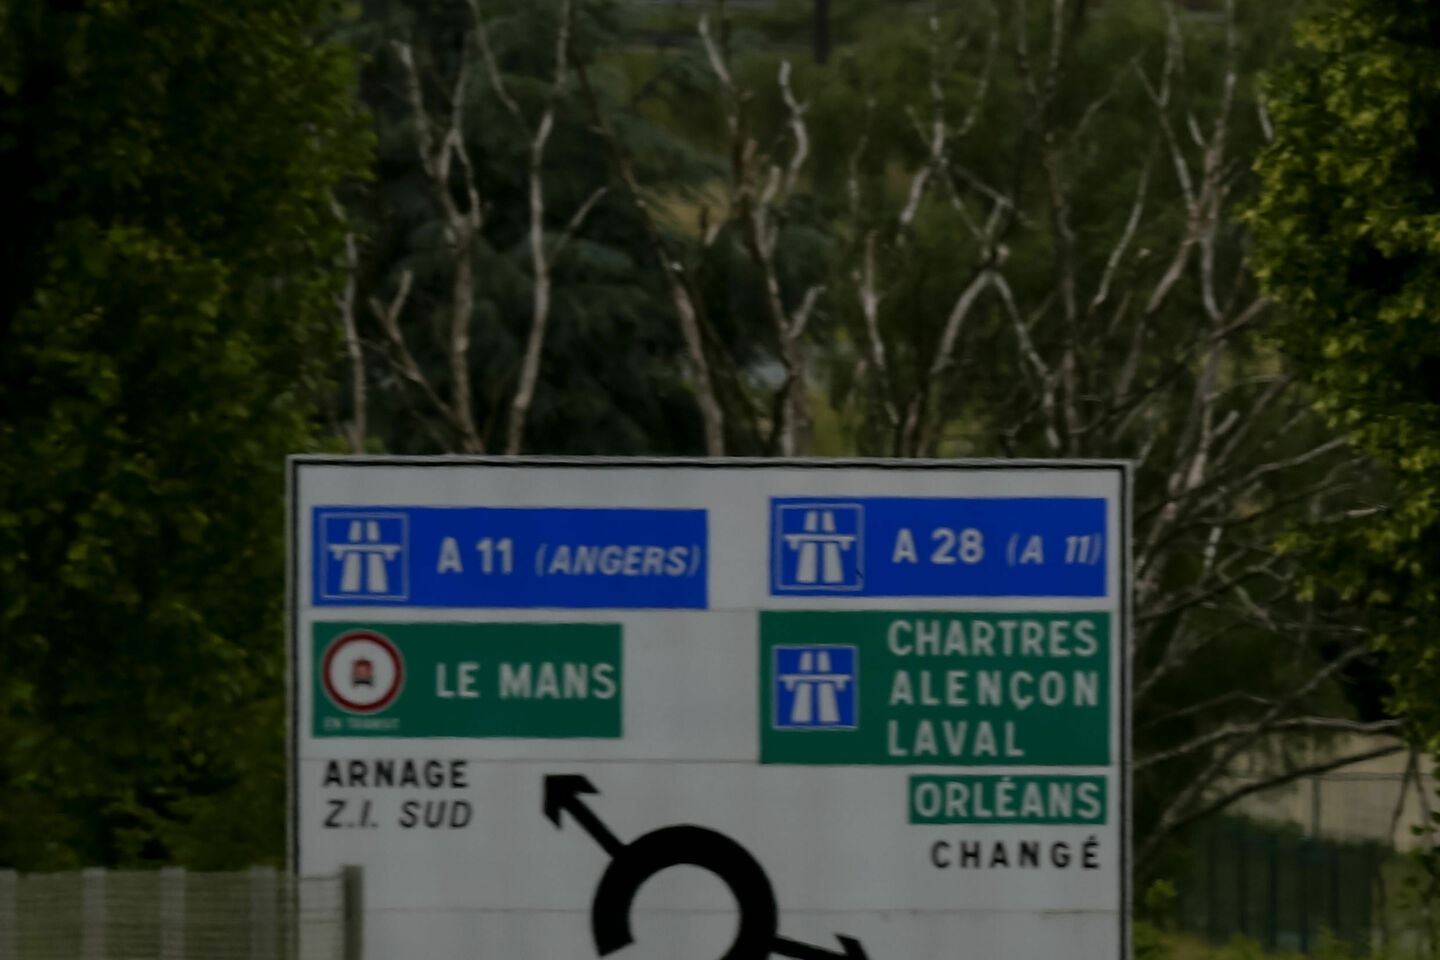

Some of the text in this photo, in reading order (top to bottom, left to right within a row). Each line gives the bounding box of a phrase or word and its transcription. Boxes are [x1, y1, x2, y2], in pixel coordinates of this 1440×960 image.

[437, 537, 700, 577] A 11 (ANGERS)
[892, 528, 1103, 567] A 28 (A 11)
[887, 619, 1098, 657] CHARTRES
[436, 662, 616, 700] LE MANS
[889, 670, 1098, 711] ALENÇON
[887, 719, 1025, 757] LAVAL
[322, 759, 469, 788] ARNAGE
[323, 799, 473, 829] Z.I. SUD
[914, 776, 1101, 819] ORLÉANS
[930, 836, 1101, 870] CHANGÉ
